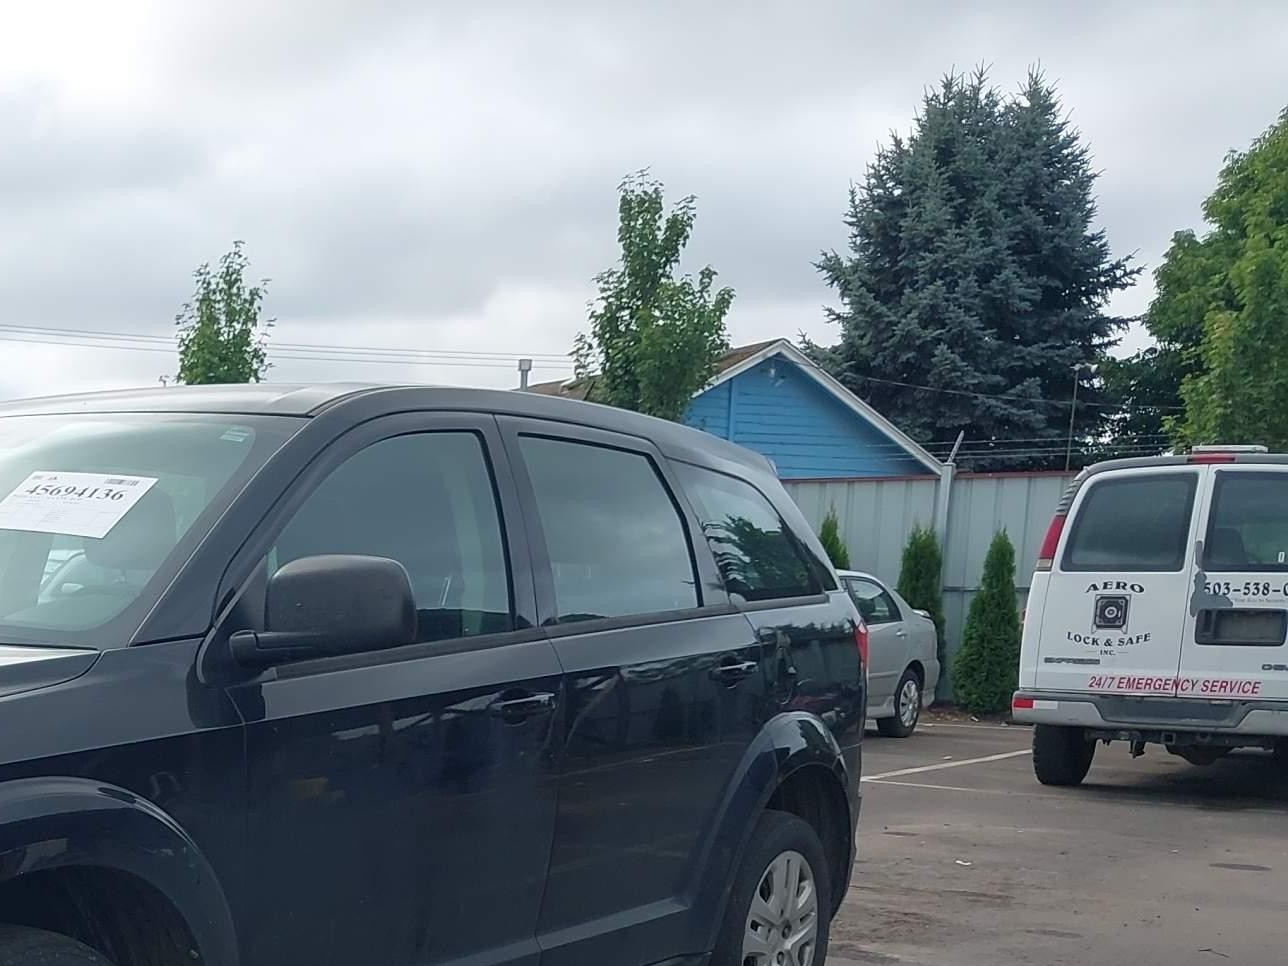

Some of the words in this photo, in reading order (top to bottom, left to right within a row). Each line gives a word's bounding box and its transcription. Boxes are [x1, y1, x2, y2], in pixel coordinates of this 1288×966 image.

[24, 484, 129, 501] 45694136
[1085, 581, 1145, 594] AERO
[1067, 631, 1100, 647] LOCK
[1103, 638, 1113, 647] &
[1117, 633, 1151, 647] SAFE
[1088, 676, 1115, 689] 24/7
[1116, 677, 1199, 692] EMERGENCY
[1201, 680, 1262, 694] SERVICE
